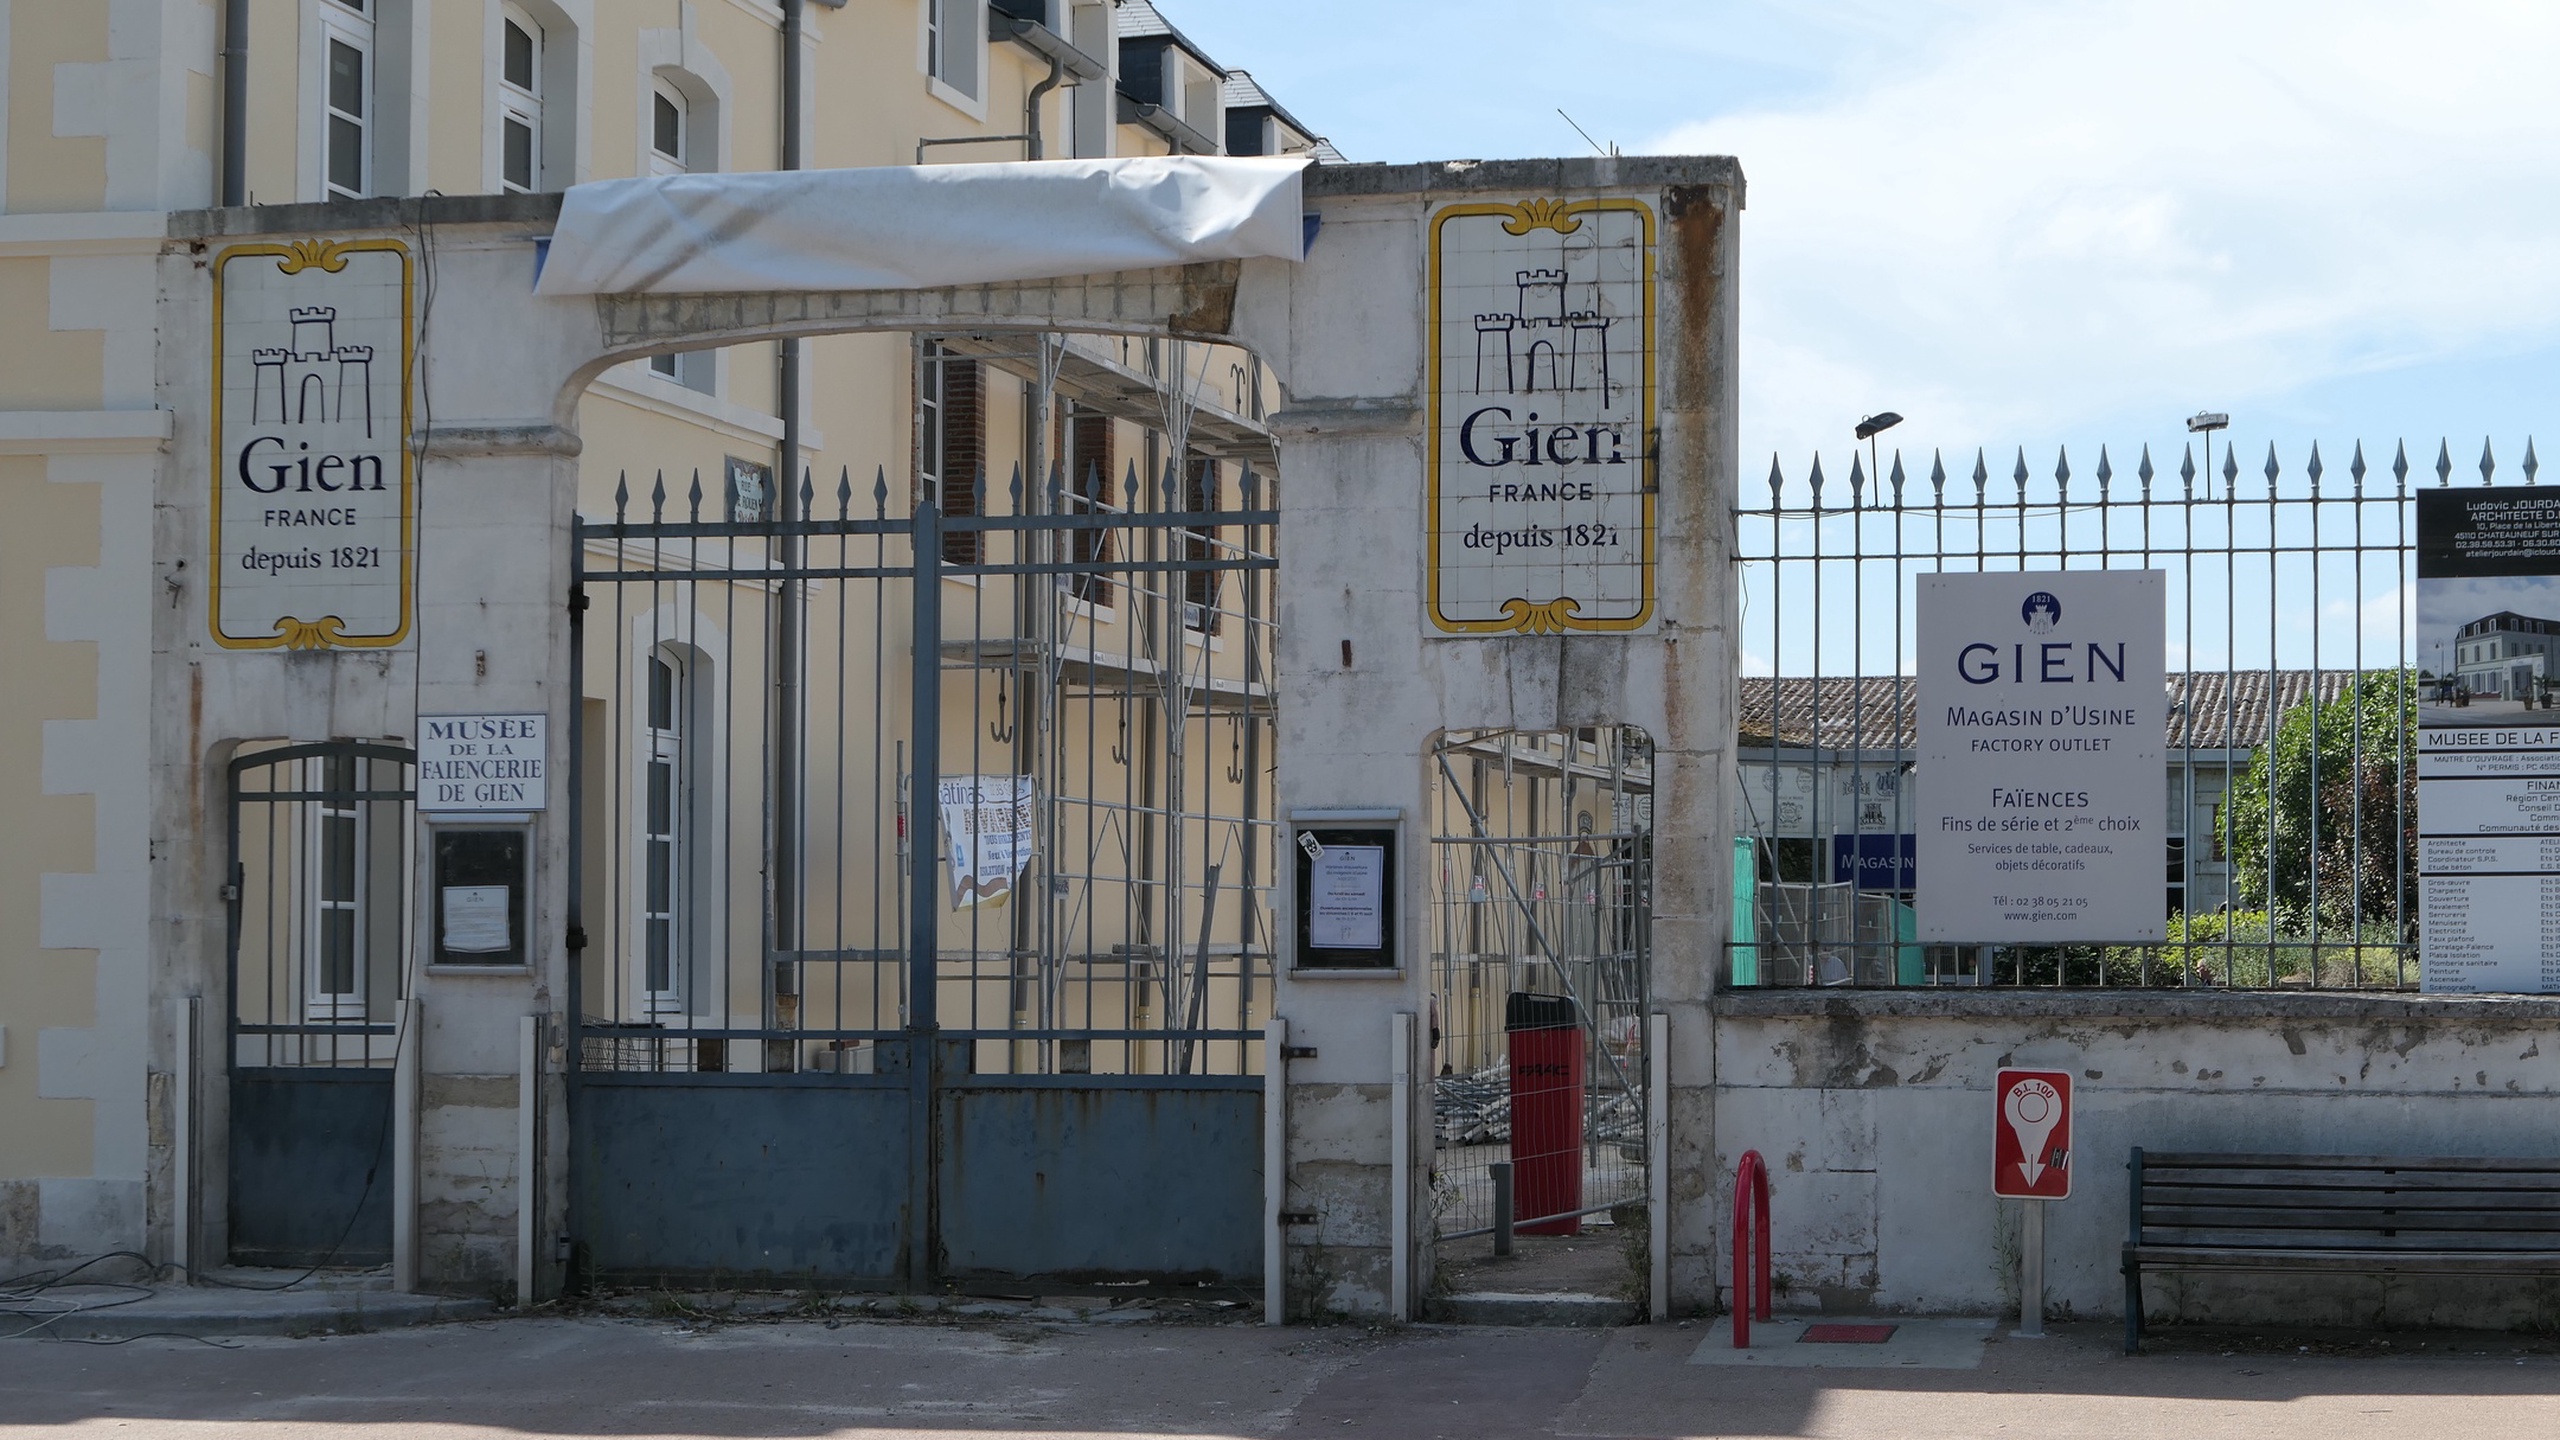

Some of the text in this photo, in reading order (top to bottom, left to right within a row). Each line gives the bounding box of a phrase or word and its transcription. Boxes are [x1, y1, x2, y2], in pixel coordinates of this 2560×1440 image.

[1460, 406, 1626, 468] Gien
[239, 436, 386, 494] Gien
[1489, 483, 1593, 503] FRANCE
[2466, 501, 2509, 511] Ludovic
[265, 508, 356, 527] FRANCE
[2471, 511, 2543, 521] ARCHITECTE
[1463, 522, 1619, 555] depuis 1821
[2542, 530, 2560, 538] SUR
[241, 545, 380, 577] depuis 1821
[2032, 595, 2051, 603] 1821
[1958, 642, 2126, 685] GIEN
[1972, 737, 2112, 753] FACTORY OUTLET
[2429, 733, 2490, 746] MUSEE
[2496, 732, 2518, 746] DE
[2524, 732, 2544, 745] LA
[450, 744, 514, 756] DE LA
[421, 759, 542, 780] FAIENCERIE
[438, 783, 525, 803] DE GIEN
[1992, 788, 2089, 808] FAÏENCES
[2506, 795, 2538, 804] Région
[2518, 804, 2552, 812] Conseil
[1941, 816, 1973, 833] Fins
[1977, 816, 1997, 832] de
[2001, 816, 2040, 832] série
[2043, 817, 2060, 832] et
[2098, 814, 2141, 832] choix
[2478, 823, 2560, 832] Communauté des
[1968, 842, 2114, 856] Services de table, cadeaux,
[1995, 858, 2086, 873] objets décoratifs
[1992, 896, 2009, 907] Tél
[2016, 898, 2029, 907] 02
[2032, 896, 2045, 908] 38
[2046, 897, 2060, 908] 05
[2061, 897, 2074, 907] 21
[2075, 897, 2089, 908] 05
[2004, 910, 2078, 922] www.gien.com
[2013, 1083, 2055, 1099] B.I. 100
